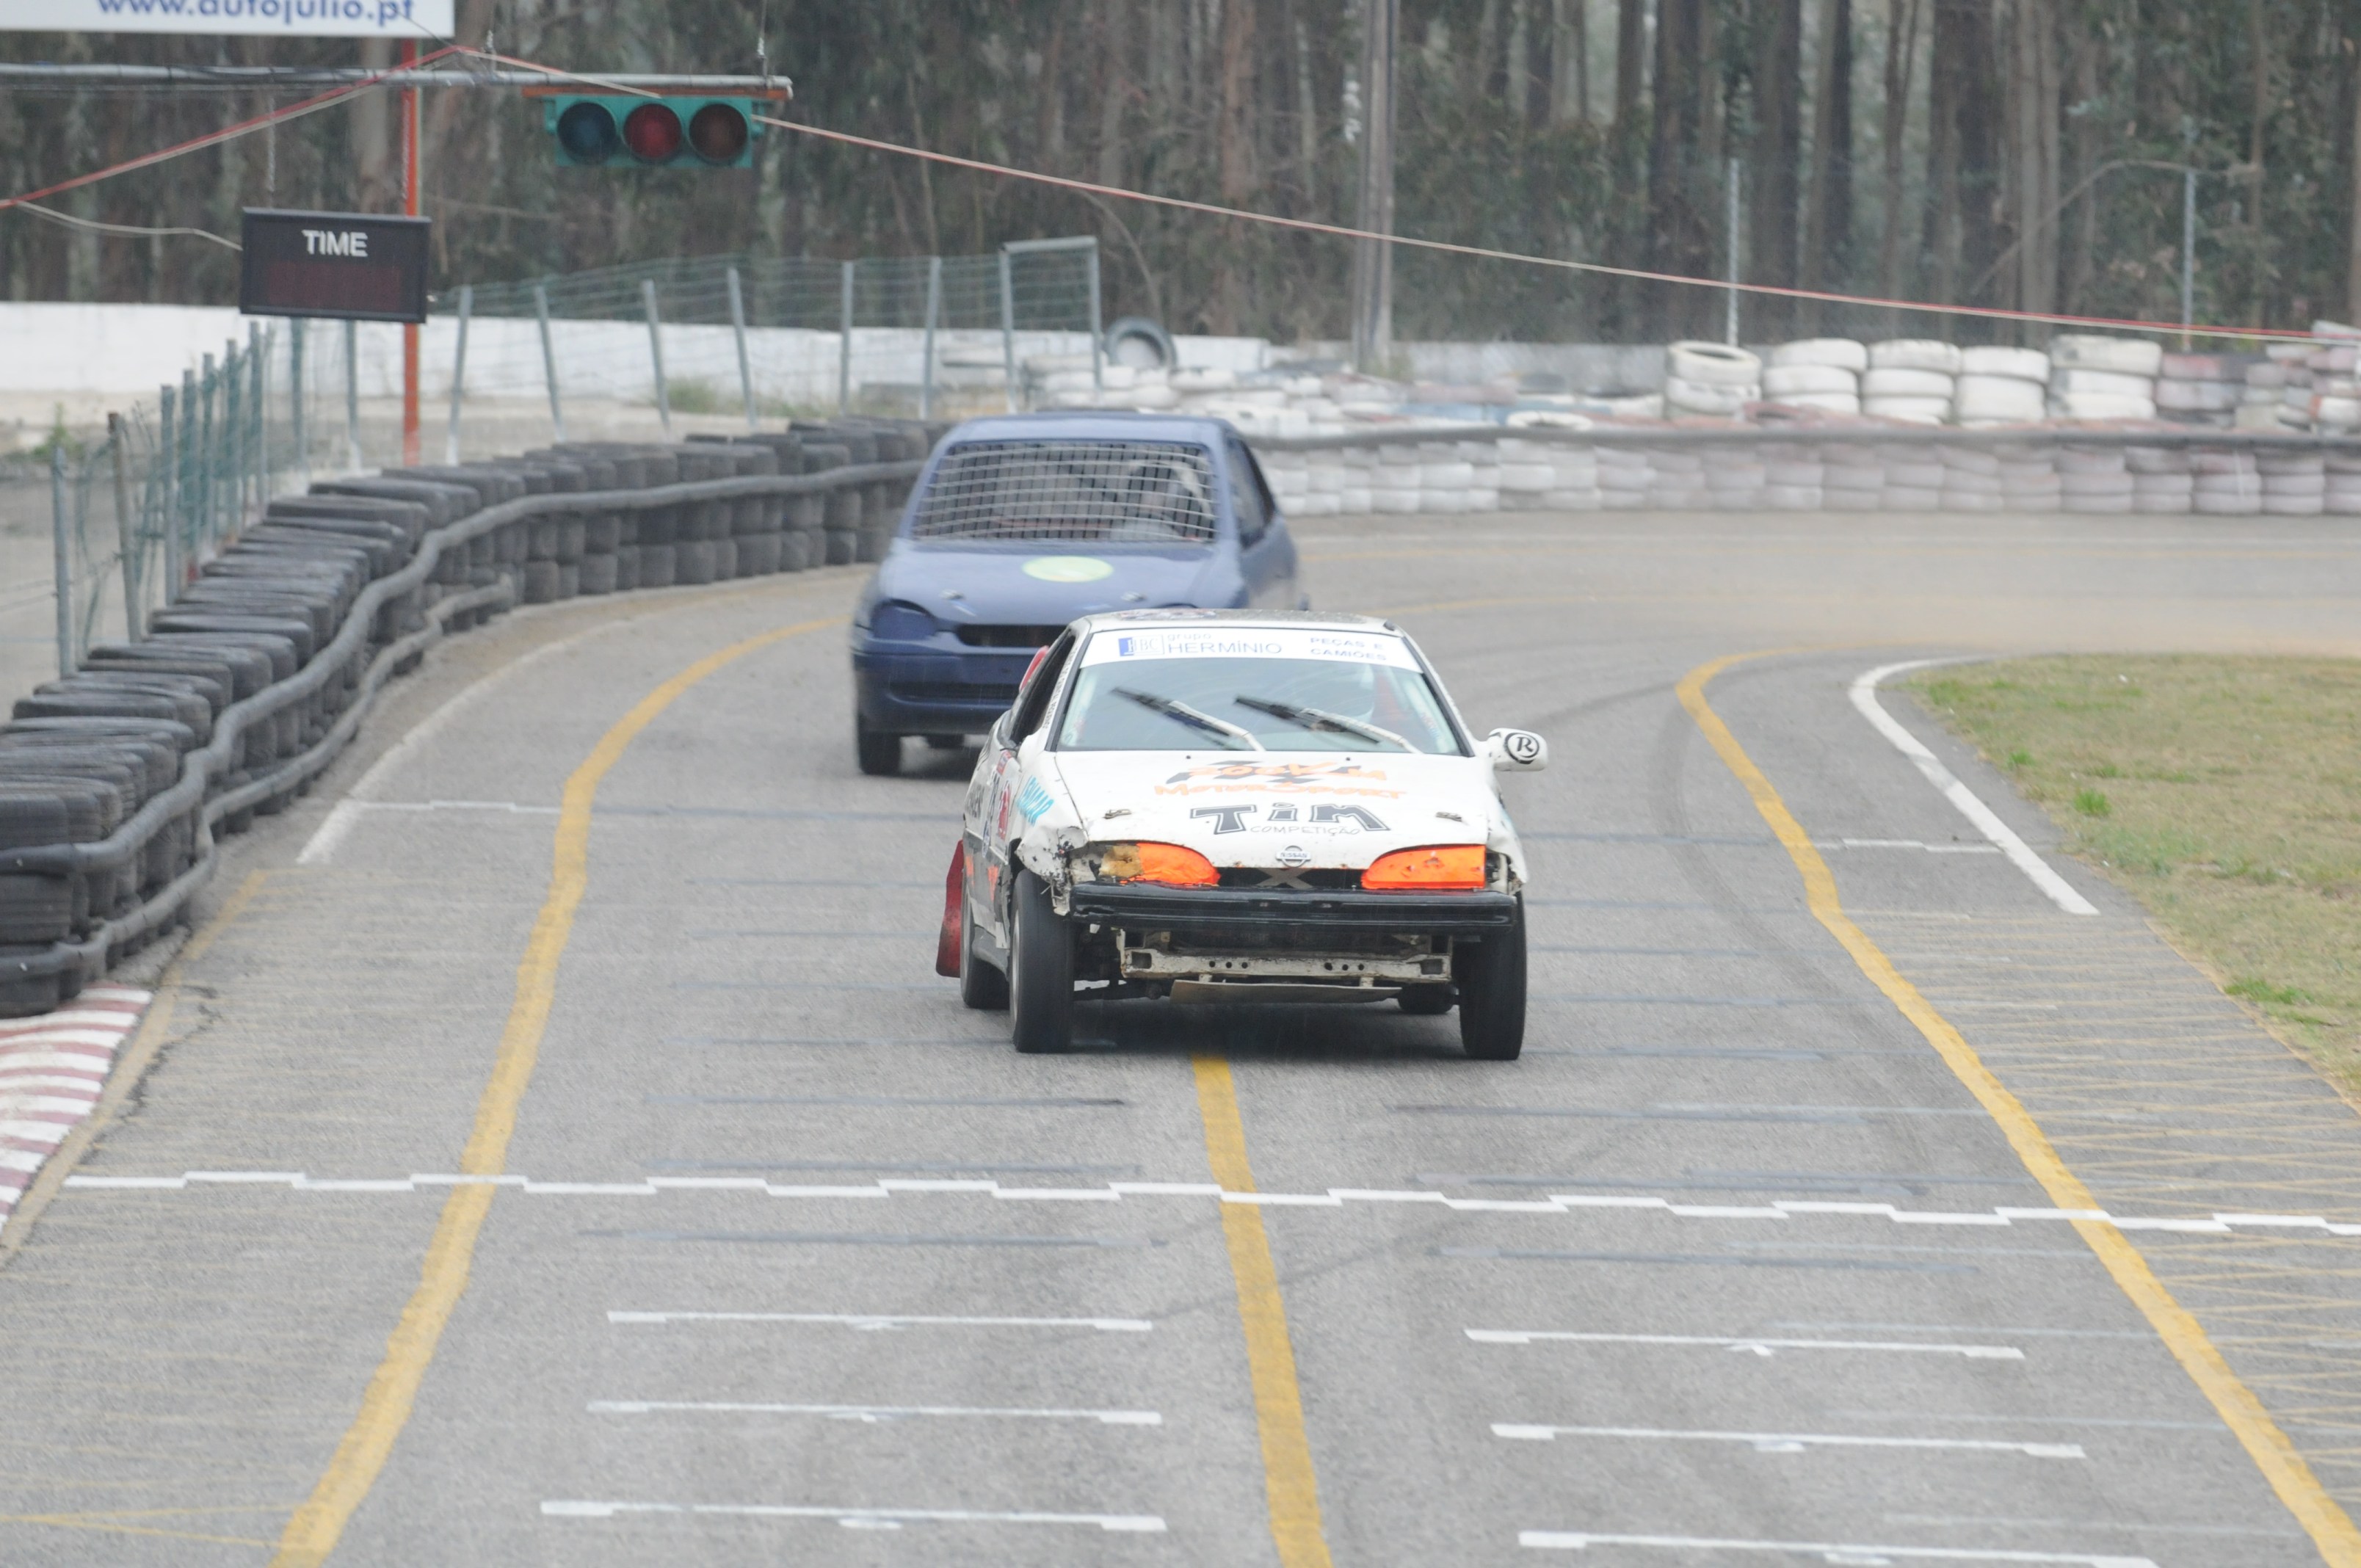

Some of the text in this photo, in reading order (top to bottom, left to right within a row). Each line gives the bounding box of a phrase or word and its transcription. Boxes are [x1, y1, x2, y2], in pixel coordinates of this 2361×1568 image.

[301, 229, 369, 257] TIME
[1167, 633, 1212, 641] grupo
[1168, 640, 1283, 654] HERMÍNIO
[1250, 825, 1361, 836] COMPETIÇÃO
